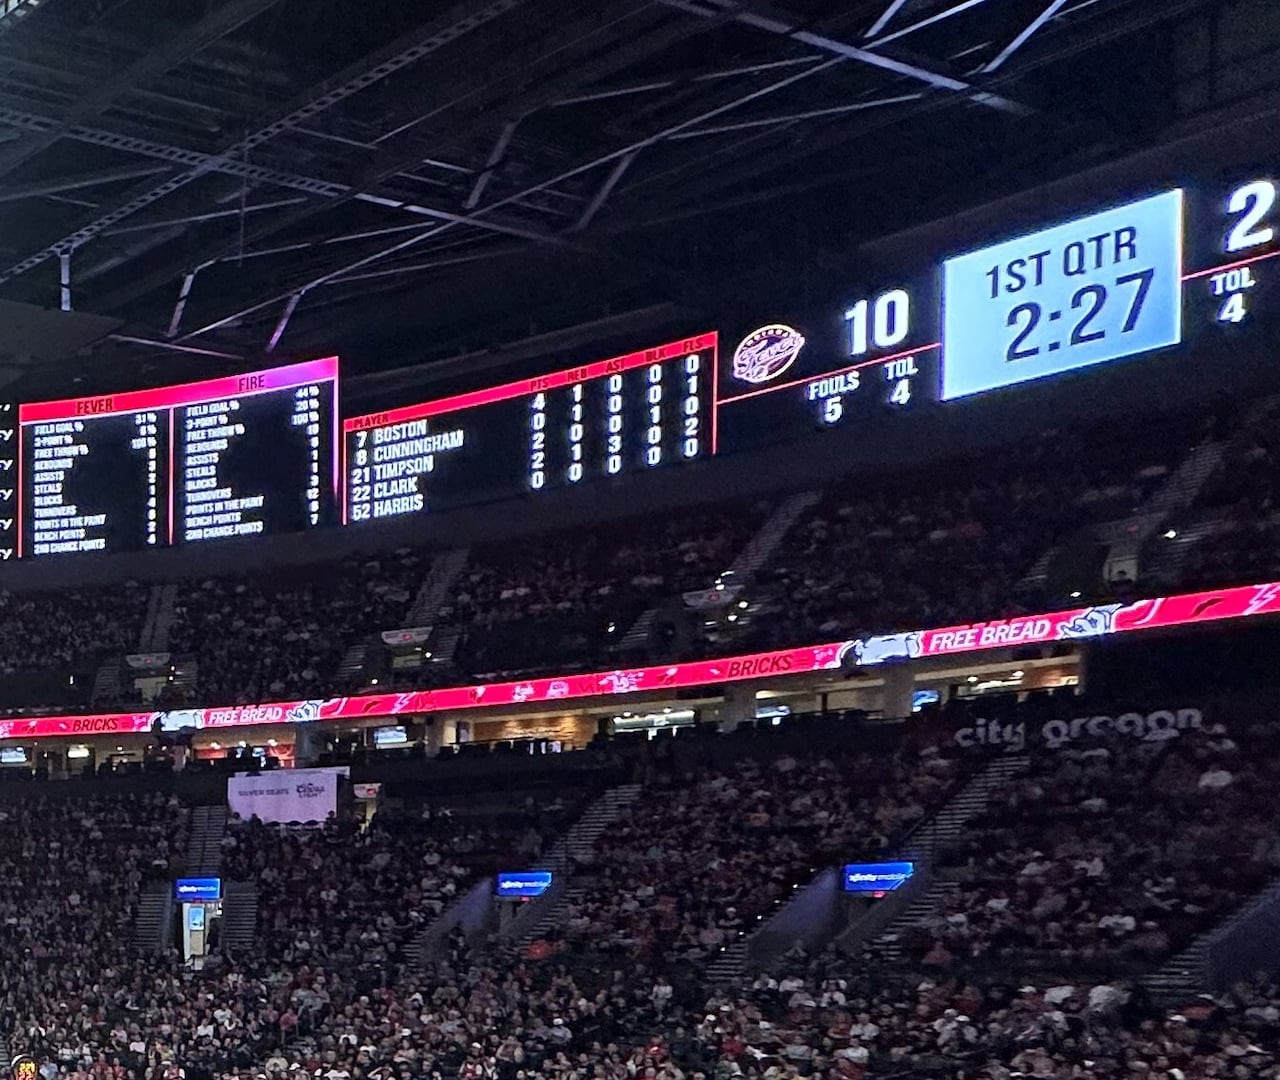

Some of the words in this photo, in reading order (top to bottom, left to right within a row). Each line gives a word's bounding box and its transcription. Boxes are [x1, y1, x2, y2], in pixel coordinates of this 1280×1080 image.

[985, 250, 1051, 299] 1ST
[1063, 226, 1137, 276] QTR
[1210, 266, 1255, 294] TOL
[844, 289, 910, 355] 10
[1005, 267, 1154, 363] 2:27
[1218, 293, 1245, 324] 4
[239, 375, 265, 391] FIRE
[353, 413, 389, 428] PLAYER
[567, 368, 587, 382] REB
[605, 358, 625, 372] AST
[645, 347, 666, 362] BLK
[683, 337, 703, 352] FLS
[885, 357, 918, 380] TOL
[357, 431, 366, 448] 7
[374, 420, 427, 445] BOSTON
[532, 393, 545, 411] 4
[572, 384, 582, 401] 1
[609, 375, 622, 393] 0
[649, 364, 662, 383] 0
[685, 354, 699, 373] 0
[809, 371, 860, 401] FOULS
[889, 379, 911, 406] 4
[77, 399, 113, 414] FEVER
[356, 449, 367, 467] 8
[374, 430, 464, 462] CUNNINGHAM
[533, 413, 544, 431] 0
[572, 404, 582, 421] 1
[609, 395, 622, 413] 0
[649, 386, 661, 403] 0
[686, 376, 698, 393] 1
[823, 397, 843, 424] 5
[352, 468, 371, 484] 21
[374, 456, 433, 481] TIMPSON
[532, 432, 544, 450] 2
[570, 424, 583, 442] 0
[609, 415, 622, 433] 0
[649, 406, 660, 423] 1
[685, 396, 698, 415] 0
[352, 486, 371, 502] 22
[374, 477, 418, 498] CLARK
[532, 451, 544, 469] 2
[571, 444, 582, 461] 1
[608, 435, 622, 453] 3
[648, 426, 661, 444] 0
[684, 418, 698, 436] 2
[352, 504, 371, 521] 52
[374, 494, 423, 517] HARRIS
[531, 471, 544, 489] 0
[569, 464, 582, 481] 0
[608, 455, 622, 474] 0
[647, 447, 661, 465] 0
[684, 438, 698, 457] 0
[930, 630, 976, 651] FREE
[980, 620, 1050, 645] BREAD
[728, 653, 792, 679] BRICKS
[73, 718, 118, 731] BRICKS
[208, 710, 238, 724] FREE
[242, 707, 282, 722] BREAD
